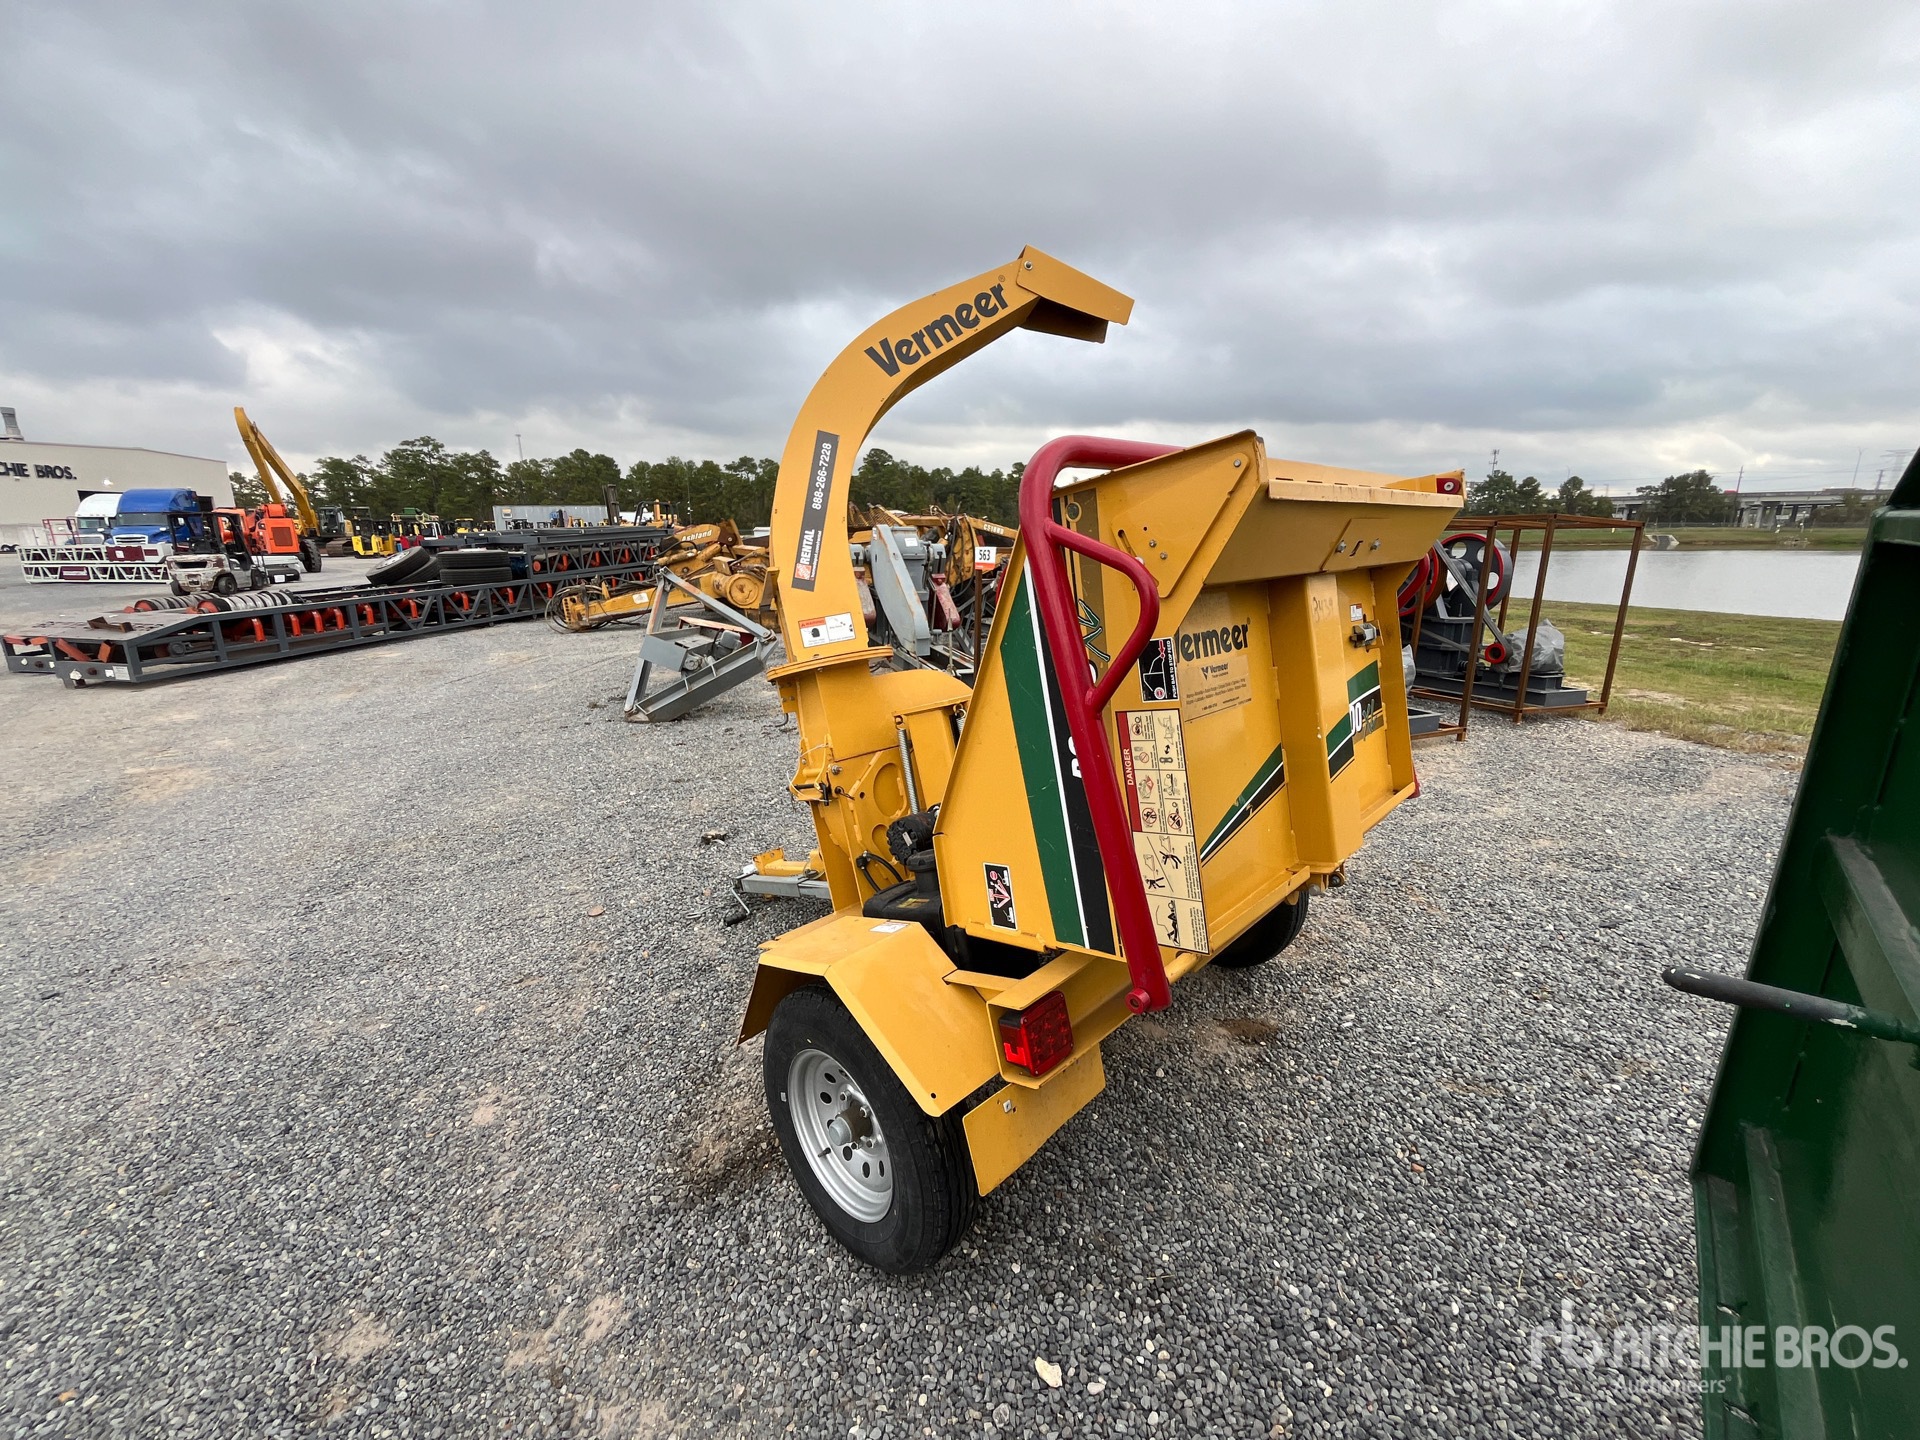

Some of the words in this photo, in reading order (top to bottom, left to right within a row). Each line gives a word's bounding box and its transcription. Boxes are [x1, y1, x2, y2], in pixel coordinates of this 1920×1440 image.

[864, 283, 1009, 377] Vermeer
[34, 464, 77, 480] BROS.
[812, 442, 832, 510] 888-266-7228
[682, 529, 712, 541] Ashland
[800, 529, 815, 565] RENTAL
[978, 549, 991, 561] 563
[1123, 748, 1134, 786] DANGER
